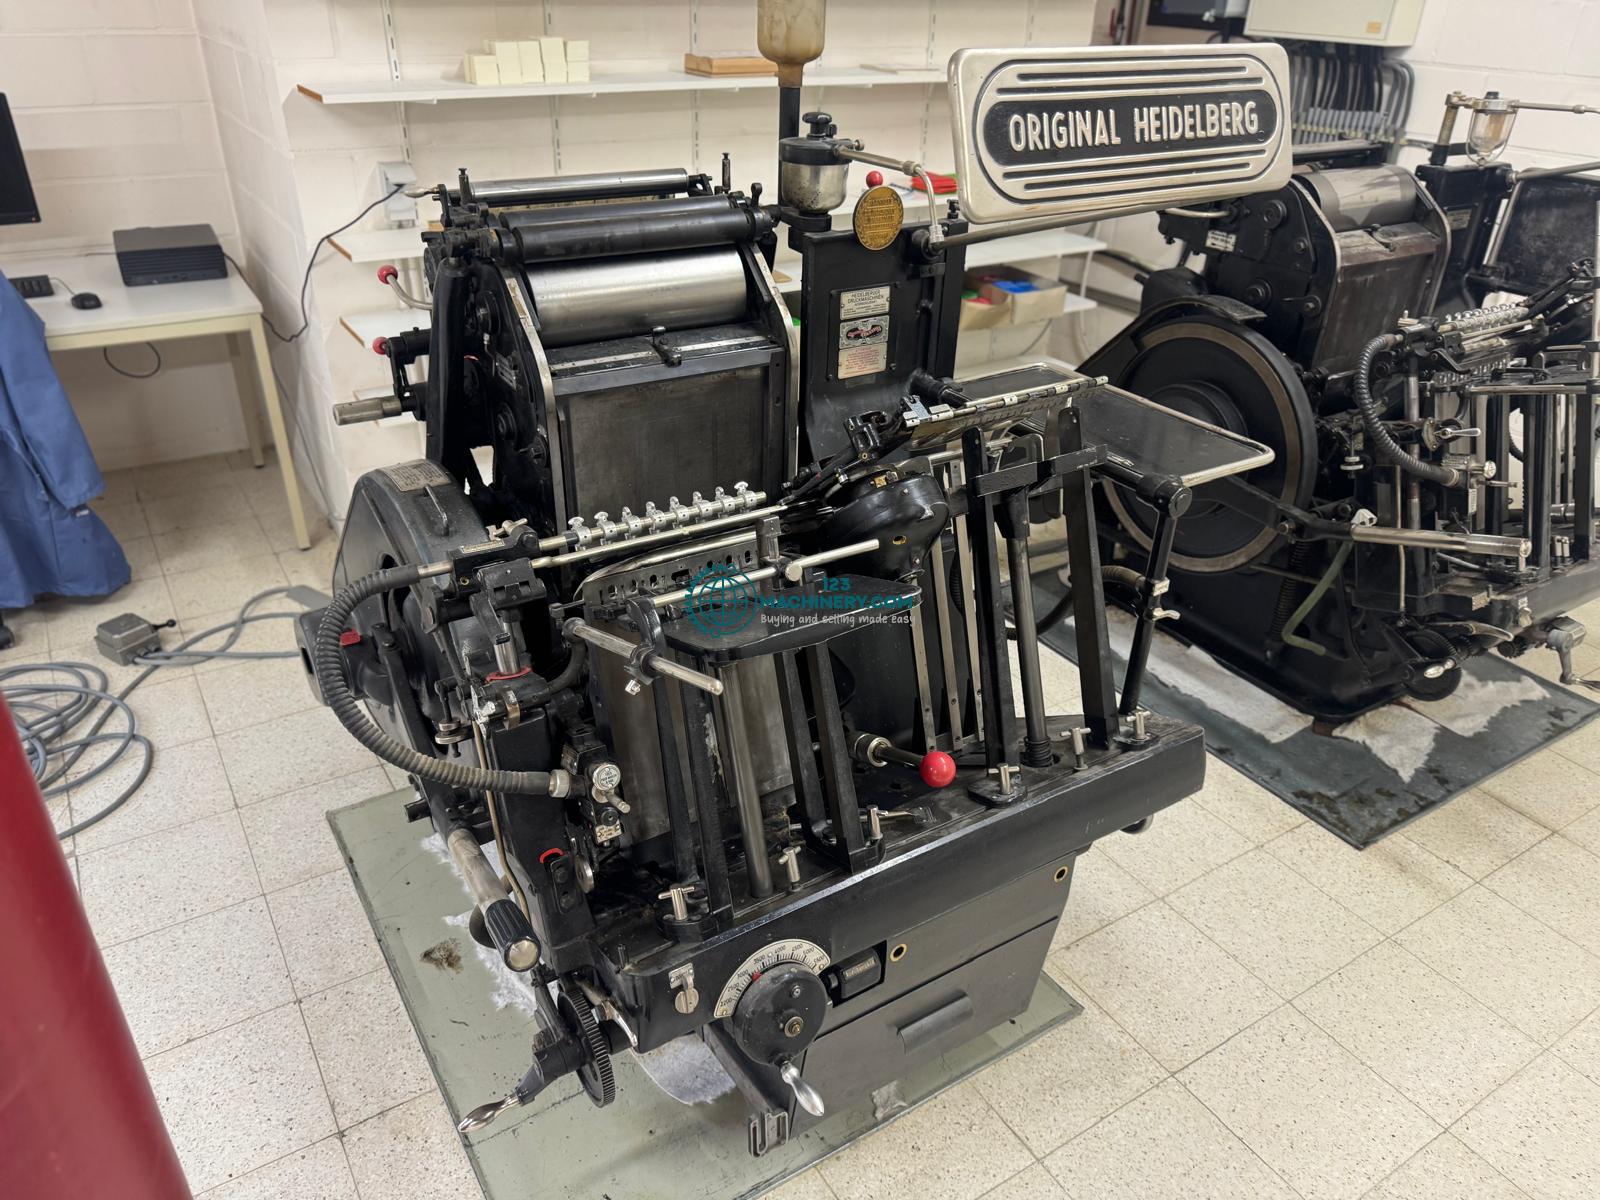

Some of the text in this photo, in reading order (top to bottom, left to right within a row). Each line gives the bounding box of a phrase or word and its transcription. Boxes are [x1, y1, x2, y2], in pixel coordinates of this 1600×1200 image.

[1009, 101, 1259, 151] ORIGINAL HEIDELBERG
[774, 944, 786, 954] 4000
